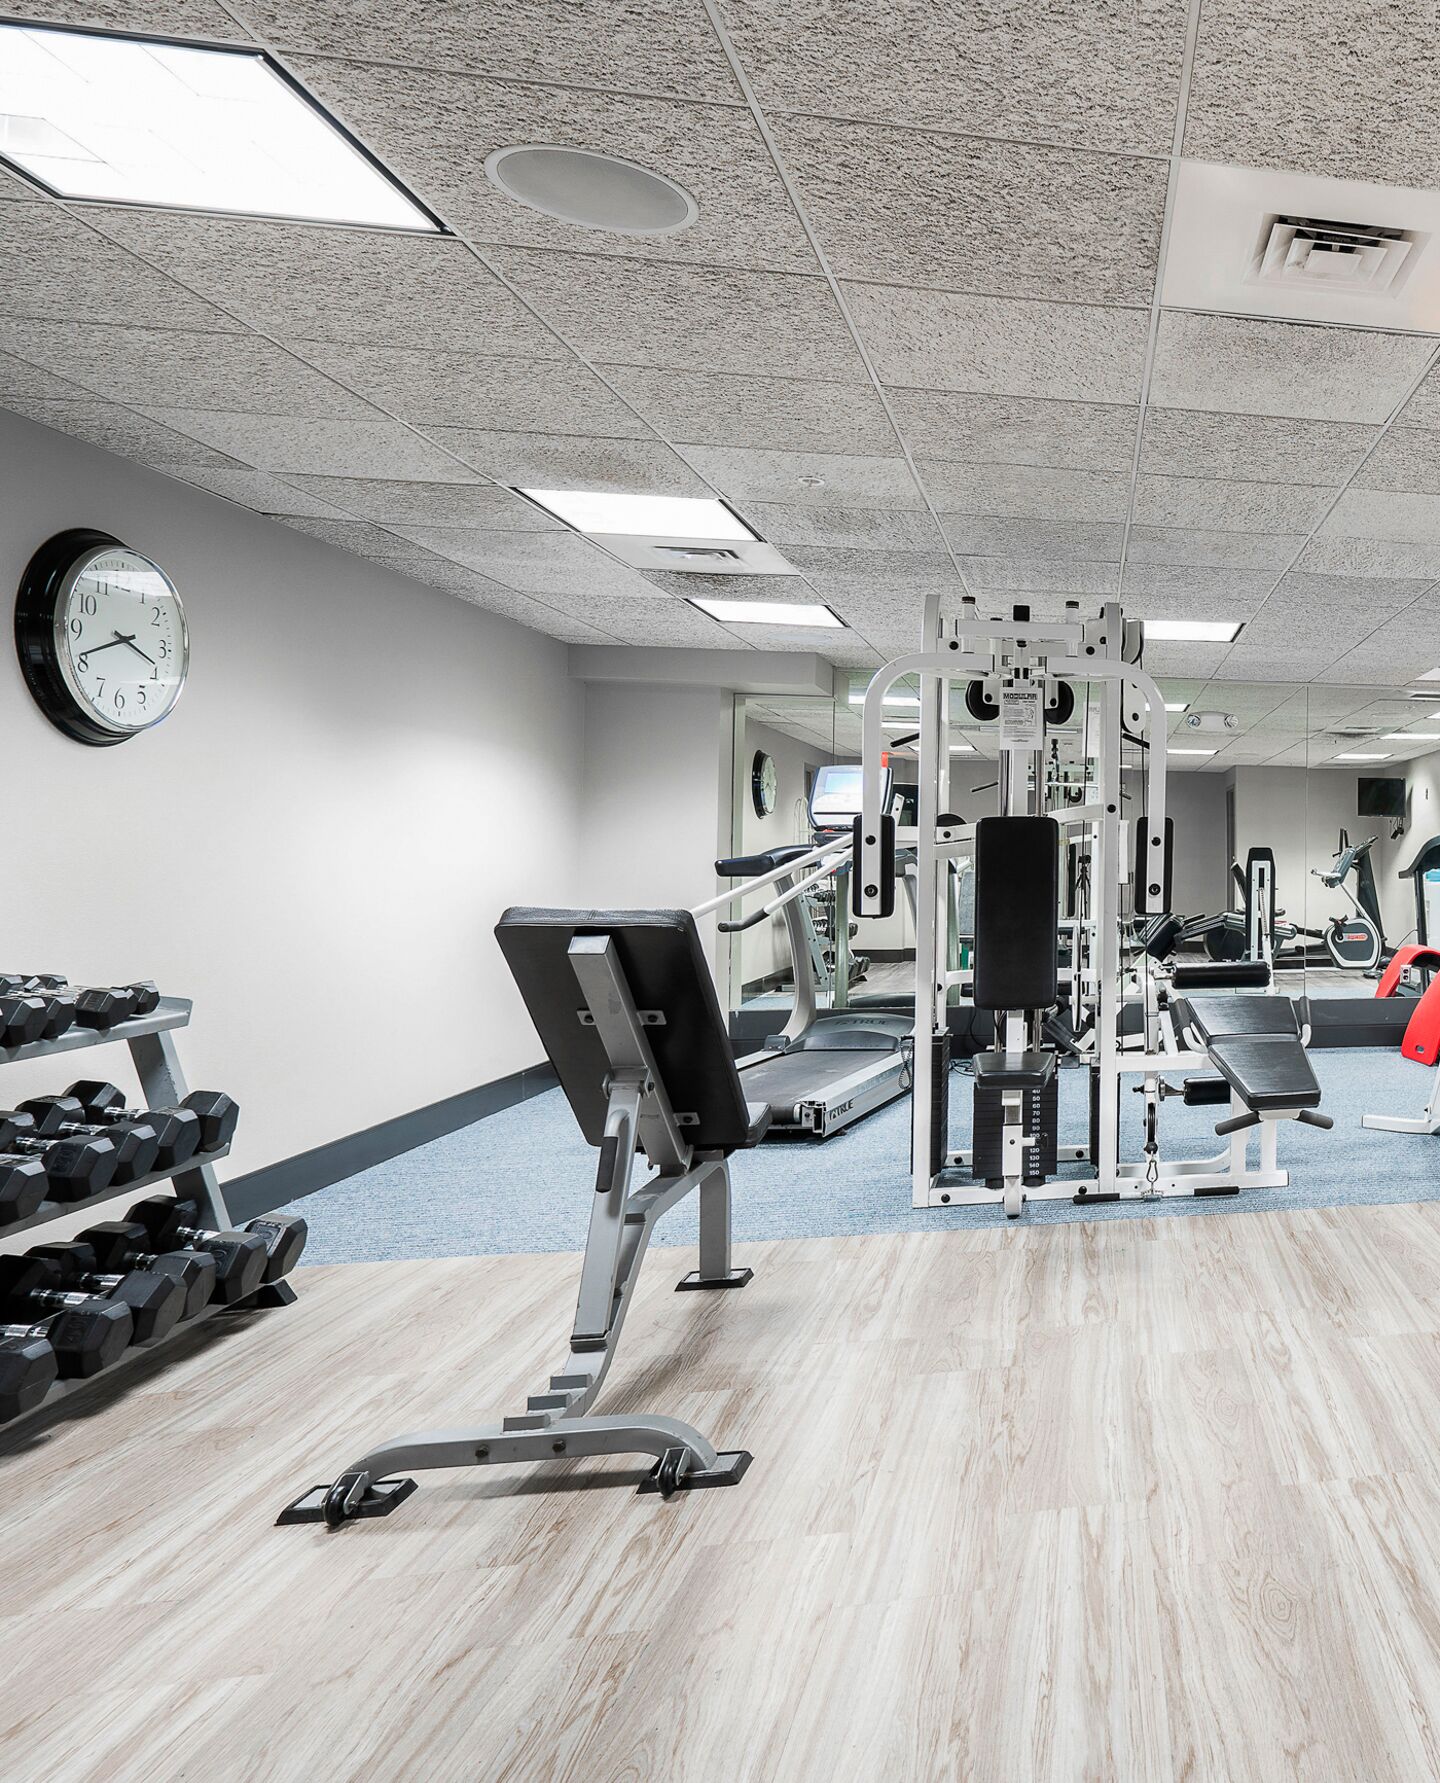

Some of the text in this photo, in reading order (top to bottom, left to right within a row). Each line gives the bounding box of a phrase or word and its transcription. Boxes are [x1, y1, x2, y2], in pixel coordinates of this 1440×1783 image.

[78, 593, 97, 616] 10
[151, 606, 160, 627] 2
[70, 618, 83, 641] 9
[158, 639, 166, 659] 3
[77, 653, 89, 673] 8
[97, 677, 106, 699] 7
[114, 687, 125, 710] 6
[137, 685, 146, 705] 5
